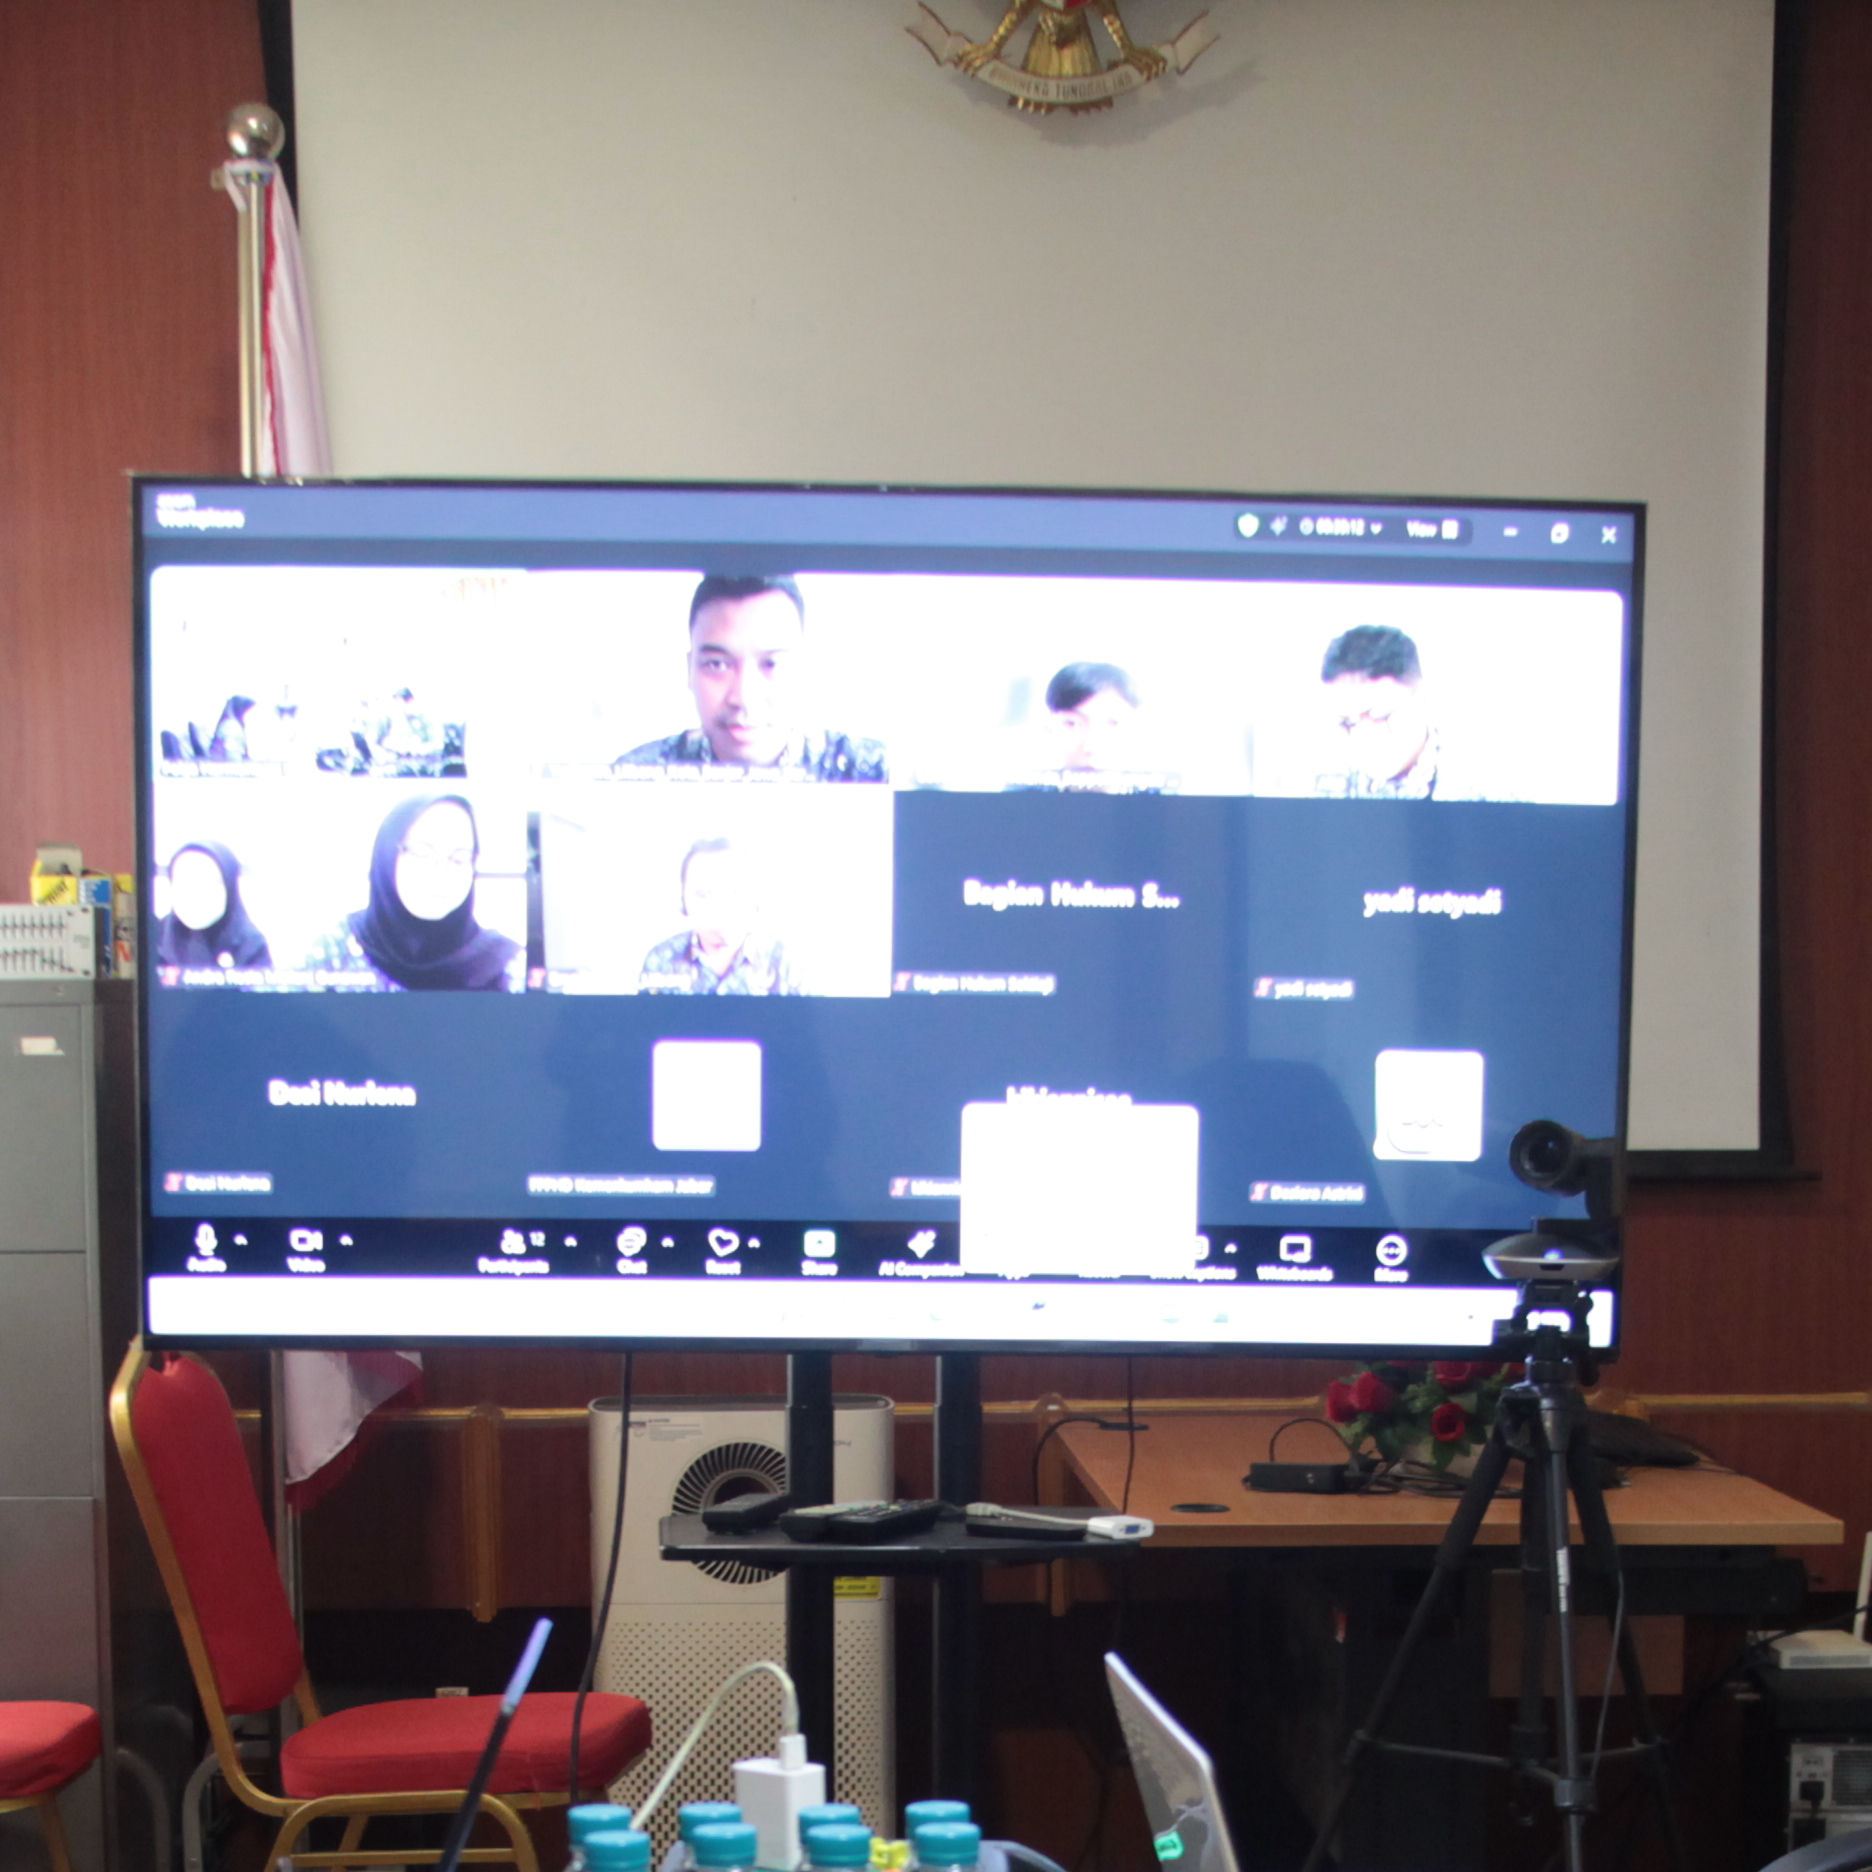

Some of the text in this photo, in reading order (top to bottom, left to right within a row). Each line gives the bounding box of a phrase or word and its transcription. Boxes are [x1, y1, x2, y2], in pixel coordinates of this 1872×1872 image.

[1405, 519, 1439, 538] View
[963, 878, 1045, 911] Bagian
[1051, 879, 1136, 908] Hukum
[1363, 886, 1415, 918] yadi
[268, 1078, 321, 1106] Desi
